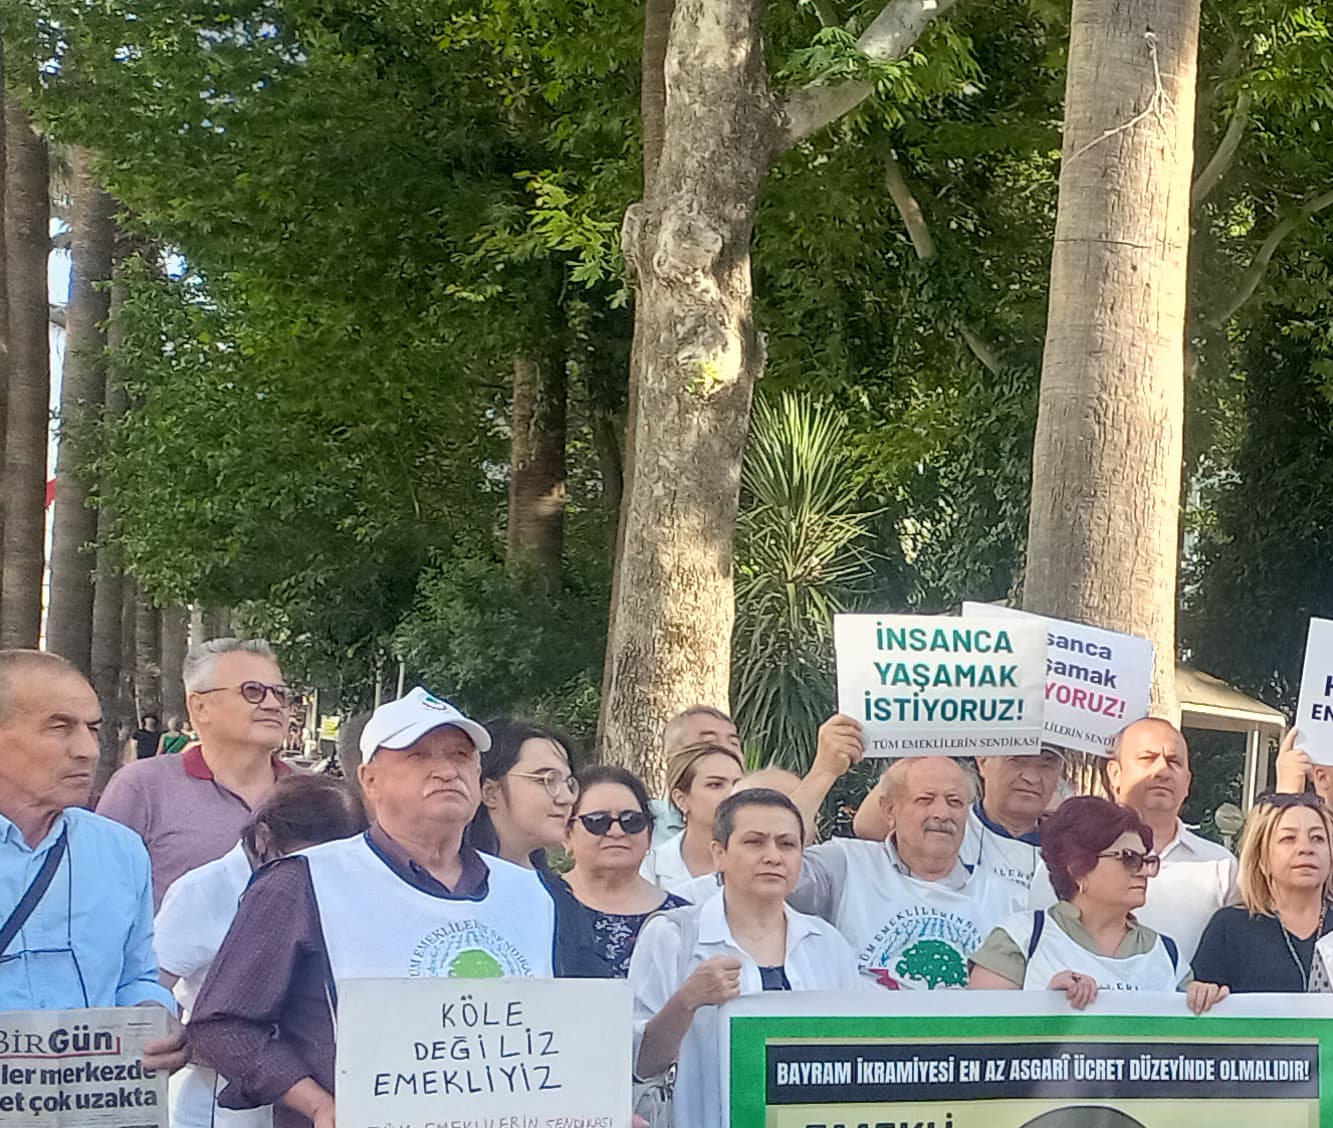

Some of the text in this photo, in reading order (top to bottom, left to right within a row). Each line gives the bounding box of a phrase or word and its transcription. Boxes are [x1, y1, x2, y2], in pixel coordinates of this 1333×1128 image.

[876, 621, 1013, 653] İNSANCA
[1046, 632, 1112, 660] sanca
[874, 661, 1018, 692] YAŞAMAK
[1046, 657, 1117, 689] şamak
[865, 690, 1024, 722] İSTİYORUZ!
[1045, 682, 1126, 719] YORUZ!
[872, 736, 1040, 750] TÜM EMEKLİLERİN SENDİKASI
[441, 994, 524, 1028] KÖLE
[2, 1060, 156, 1086] ler merkezde
[374, 1063, 563, 1097] EMEKLİYİZ
[777, 1061, 851, 1086] BAYRAM
[857, 1056, 955, 1084] İKRAMİYESİ
[959, 1060, 980, 1082] EN
[984, 1059, 1006, 1081] AZ
[1074, 1054, 1125, 1081] ÜCRET
[1130, 1054, 1215, 1081] DÜZEYİNDE
[1219, 1060, 1310, 1081] OLMALIDIR!
[0, 1087, 158, 1116] et çok uzakta
